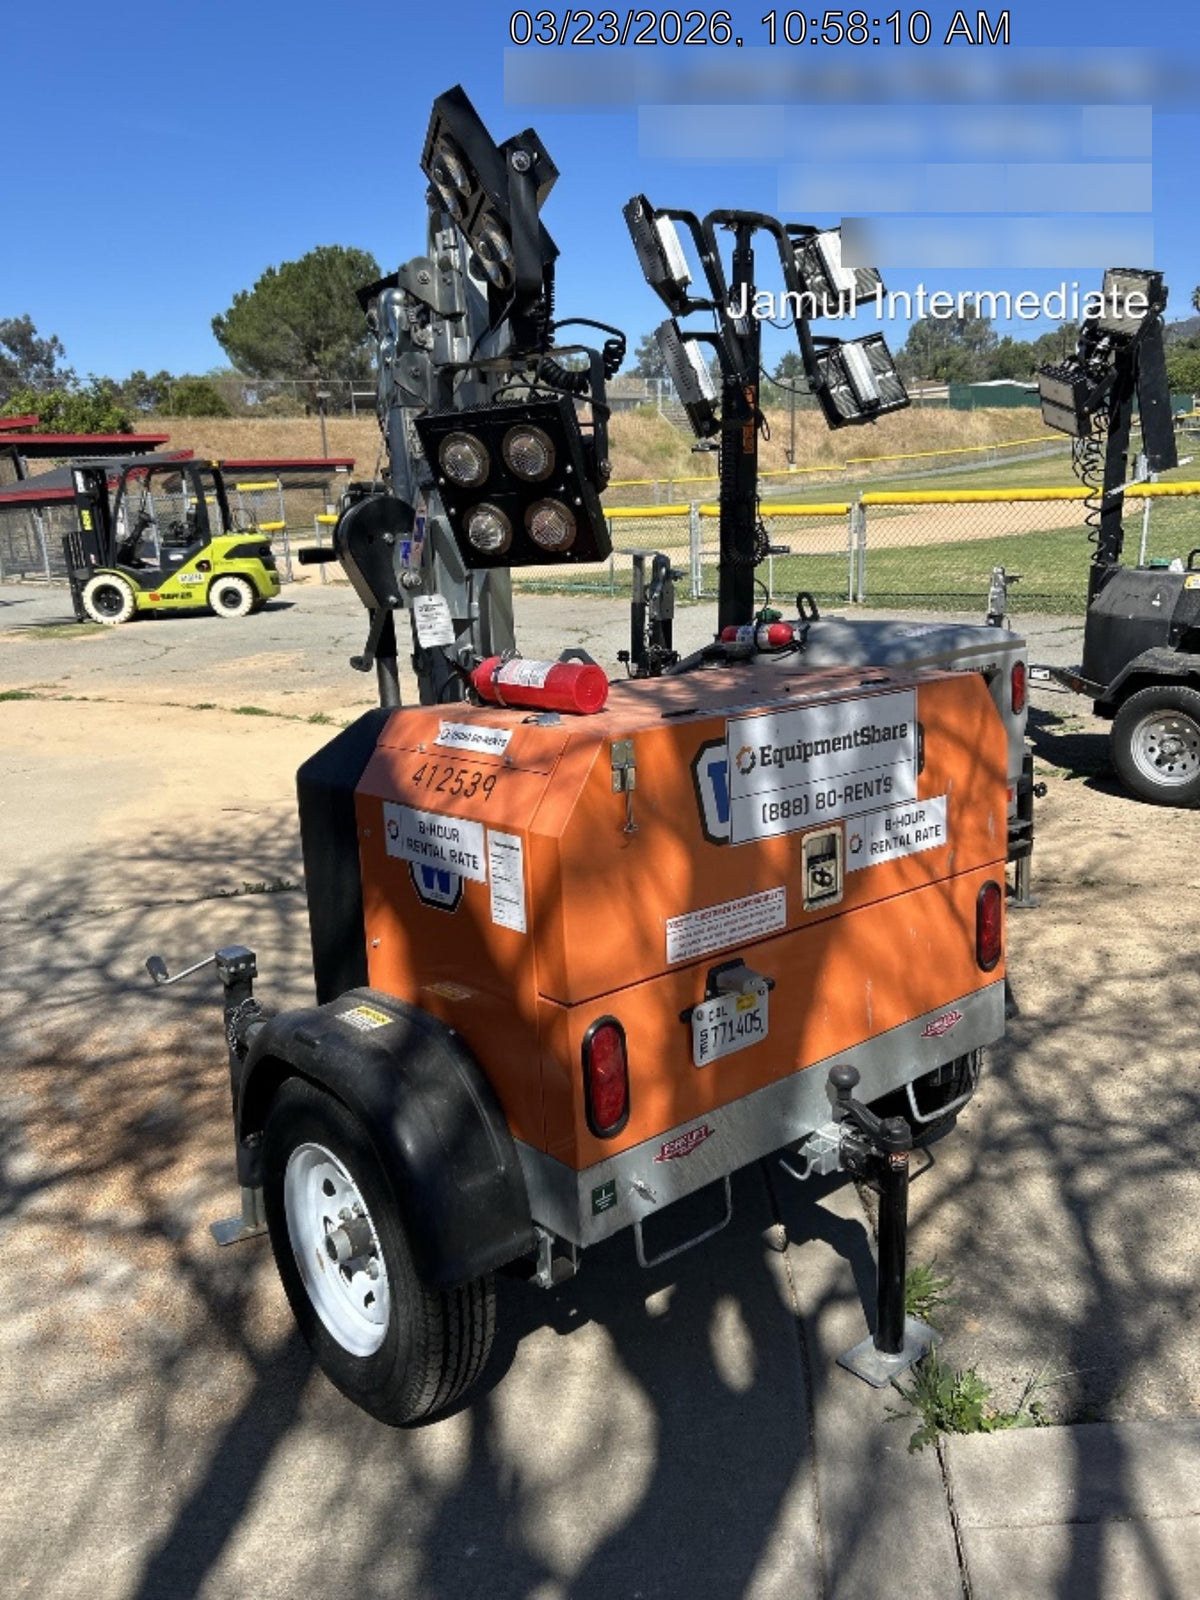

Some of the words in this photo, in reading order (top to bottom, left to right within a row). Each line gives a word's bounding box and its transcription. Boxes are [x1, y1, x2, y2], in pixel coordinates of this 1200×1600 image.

[759, 722, 908, 768] EquipmentShare
[412, 762, 497, 802] 412539
[761, 794, 810, 824] (888)
[406, 837, 447, 861] RENTAL
[449, 849, 479, 870] RATE
[870, 833, 912, 855] RENTAL
[915, 824, 942, 843] RATE
